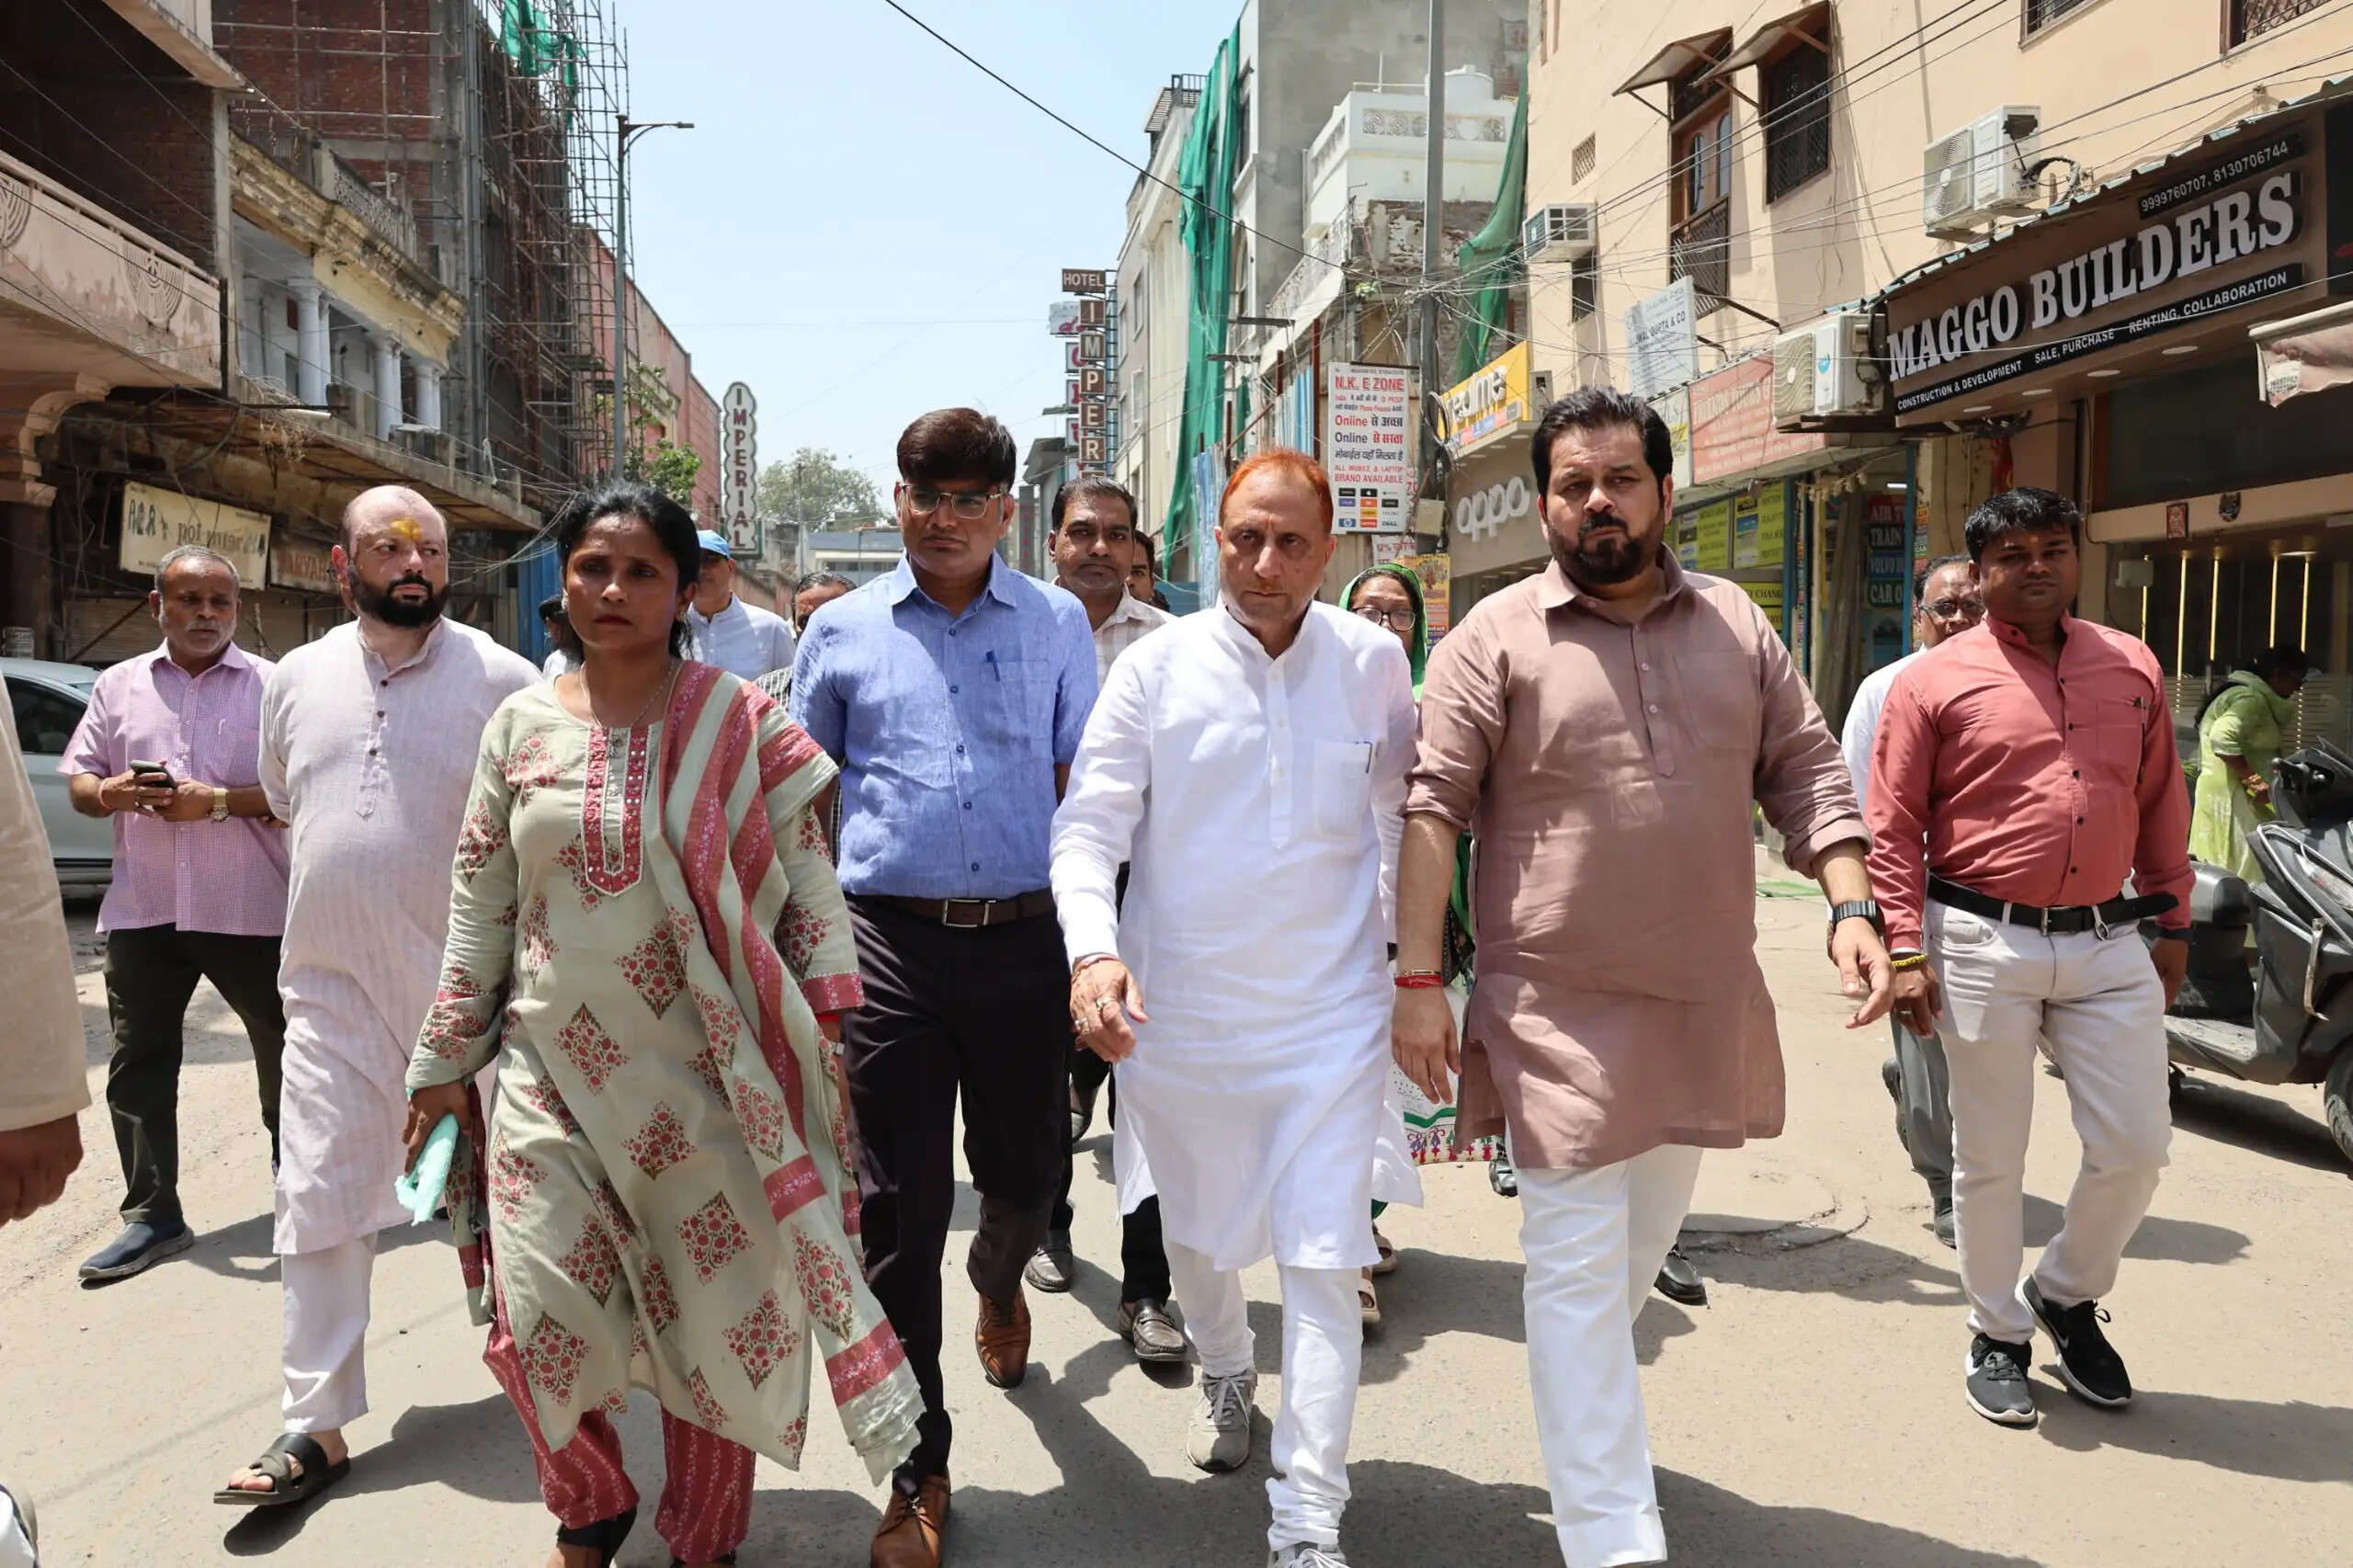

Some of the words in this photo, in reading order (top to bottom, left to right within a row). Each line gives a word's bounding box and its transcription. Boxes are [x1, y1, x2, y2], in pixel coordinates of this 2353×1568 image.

[2142, 173, 2211, 212] 9999760707,
[2213, 141, 2289, 182] 8130706744
[1063, 270, 1104, 287] HOTEL
[1886, 285, 2018, 381] MAGGO
[2030, 172, 2295, 329] BUILDERS
[1897, 384, 1952, 412] CONSTRUCTION
[1954, 381, 1961, 392] &
[1962, 359, 2022, 390] DEVELOPMENT
[2034, 347, 2061, 365] SALE,
[2063, 327, 2115, 355] PURCHASE
[2184, 271, 2287, 316] COLLABORATION
[1362, 377, 1370, 391] E
[1373, 378, 1404, 391] ZONE
[1335, 415, 1368, 426] Online
[1335, 432, 1368, 444] Online
[733, 388, 748, 547] IMPERIAL
[1335, 473, 1360, 483] BRAND
[1362, 474, 1404, 483] AVAILABLE
[1457, 476, 1530, 542] oppo
[1870, 506, 1892, 521] AIR
[1870, 528, 1902, 546] TRAIN
[1870, 585, 1893, 603] CAR
